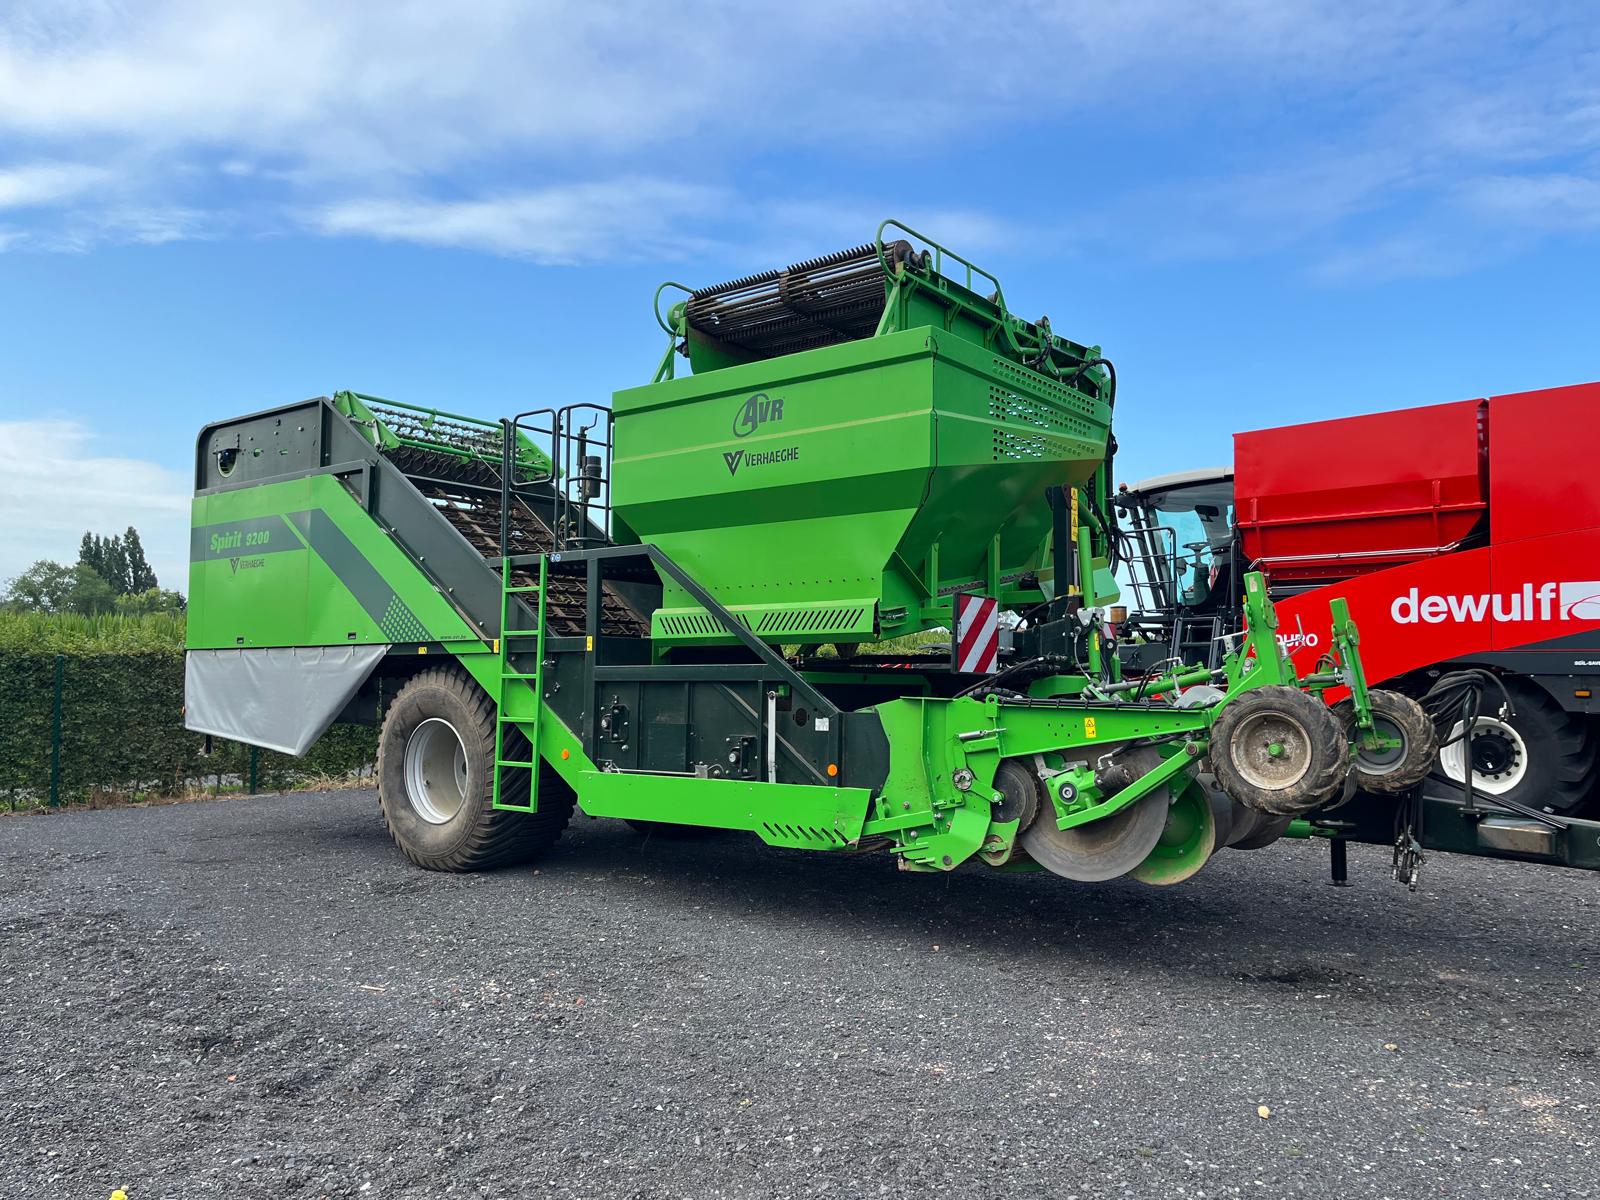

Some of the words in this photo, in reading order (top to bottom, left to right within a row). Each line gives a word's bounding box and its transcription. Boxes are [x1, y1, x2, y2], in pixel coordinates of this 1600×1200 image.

[735, 394, 785, 434] AVR
[744, 446, 799, 467] VERHAEGHE
[210, 530, 242, 554] Spirit
[246, 530, 270, 547] 9200
[1391, 582, 1557, 624] dewulf
[1275, 633, 1319, 647] DURO
